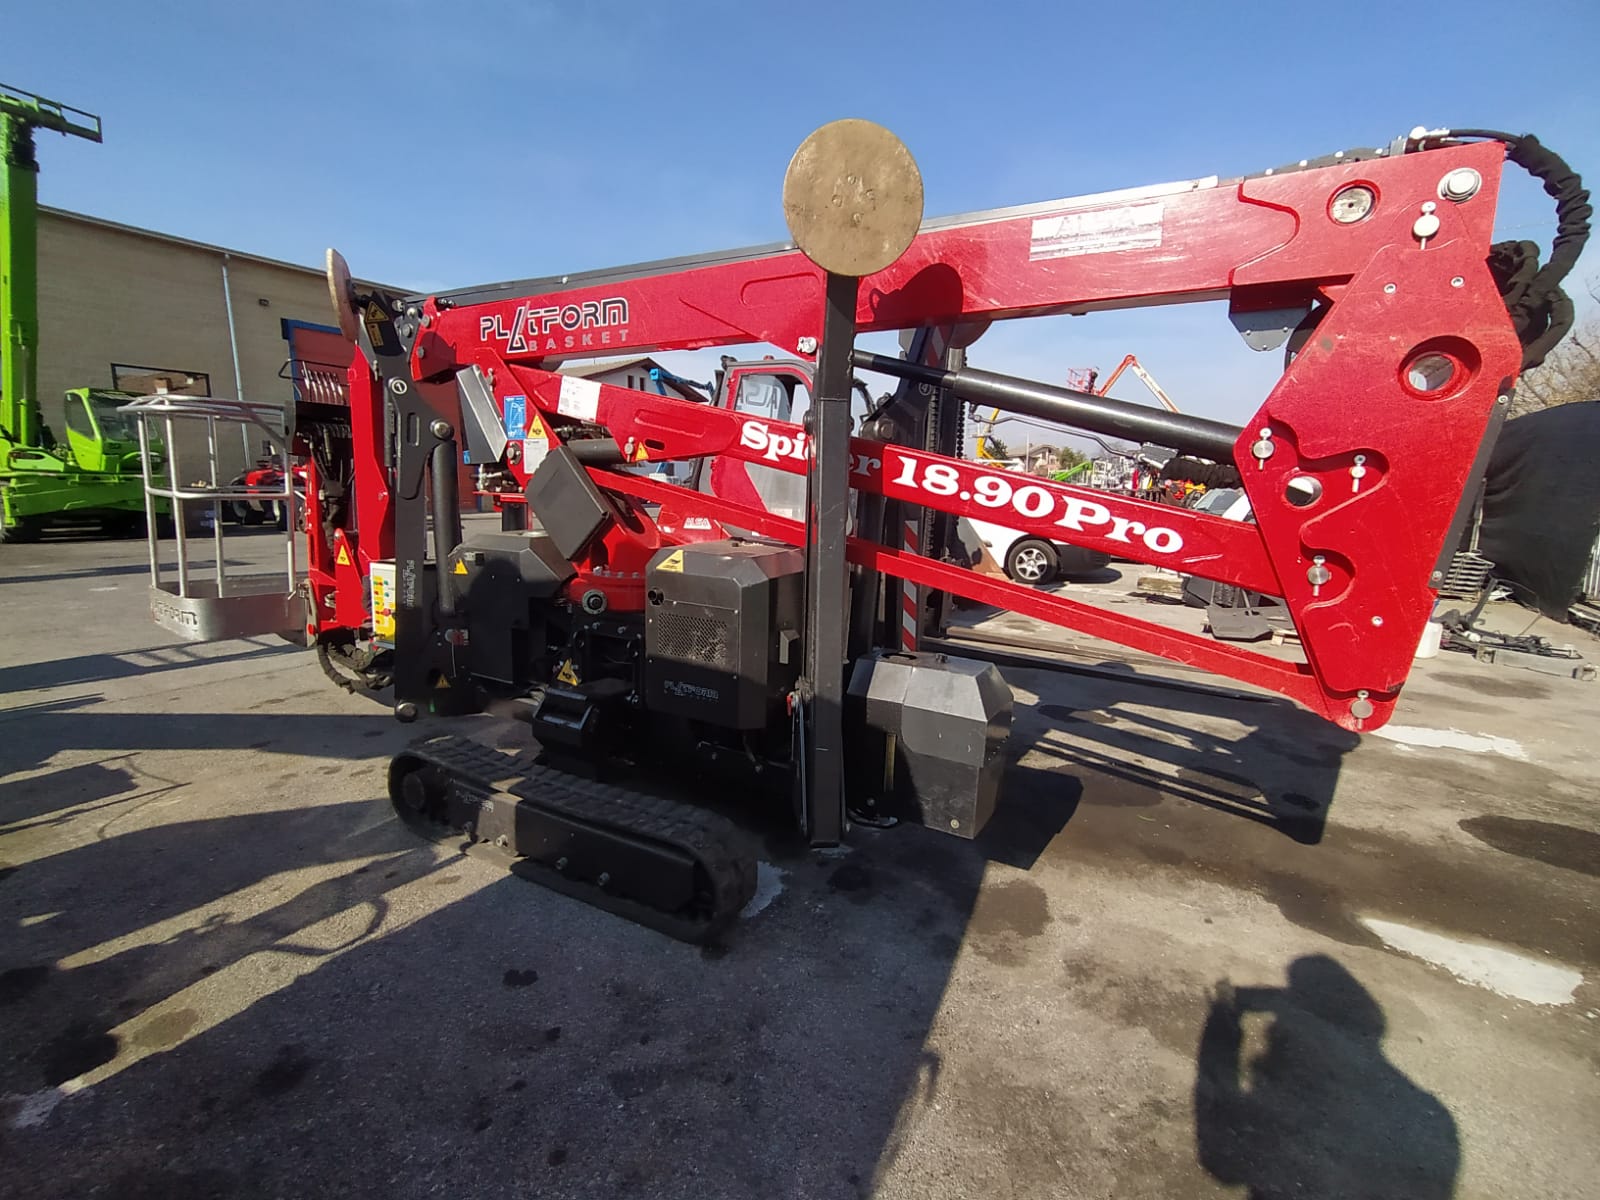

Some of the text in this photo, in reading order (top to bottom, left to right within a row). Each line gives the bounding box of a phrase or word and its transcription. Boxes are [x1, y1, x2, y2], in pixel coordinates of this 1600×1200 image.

[480, 297, 629, 354] PLATFORM
[529, 329, 629, 352] BASKET
[740, 420, 881, 478] Spir
